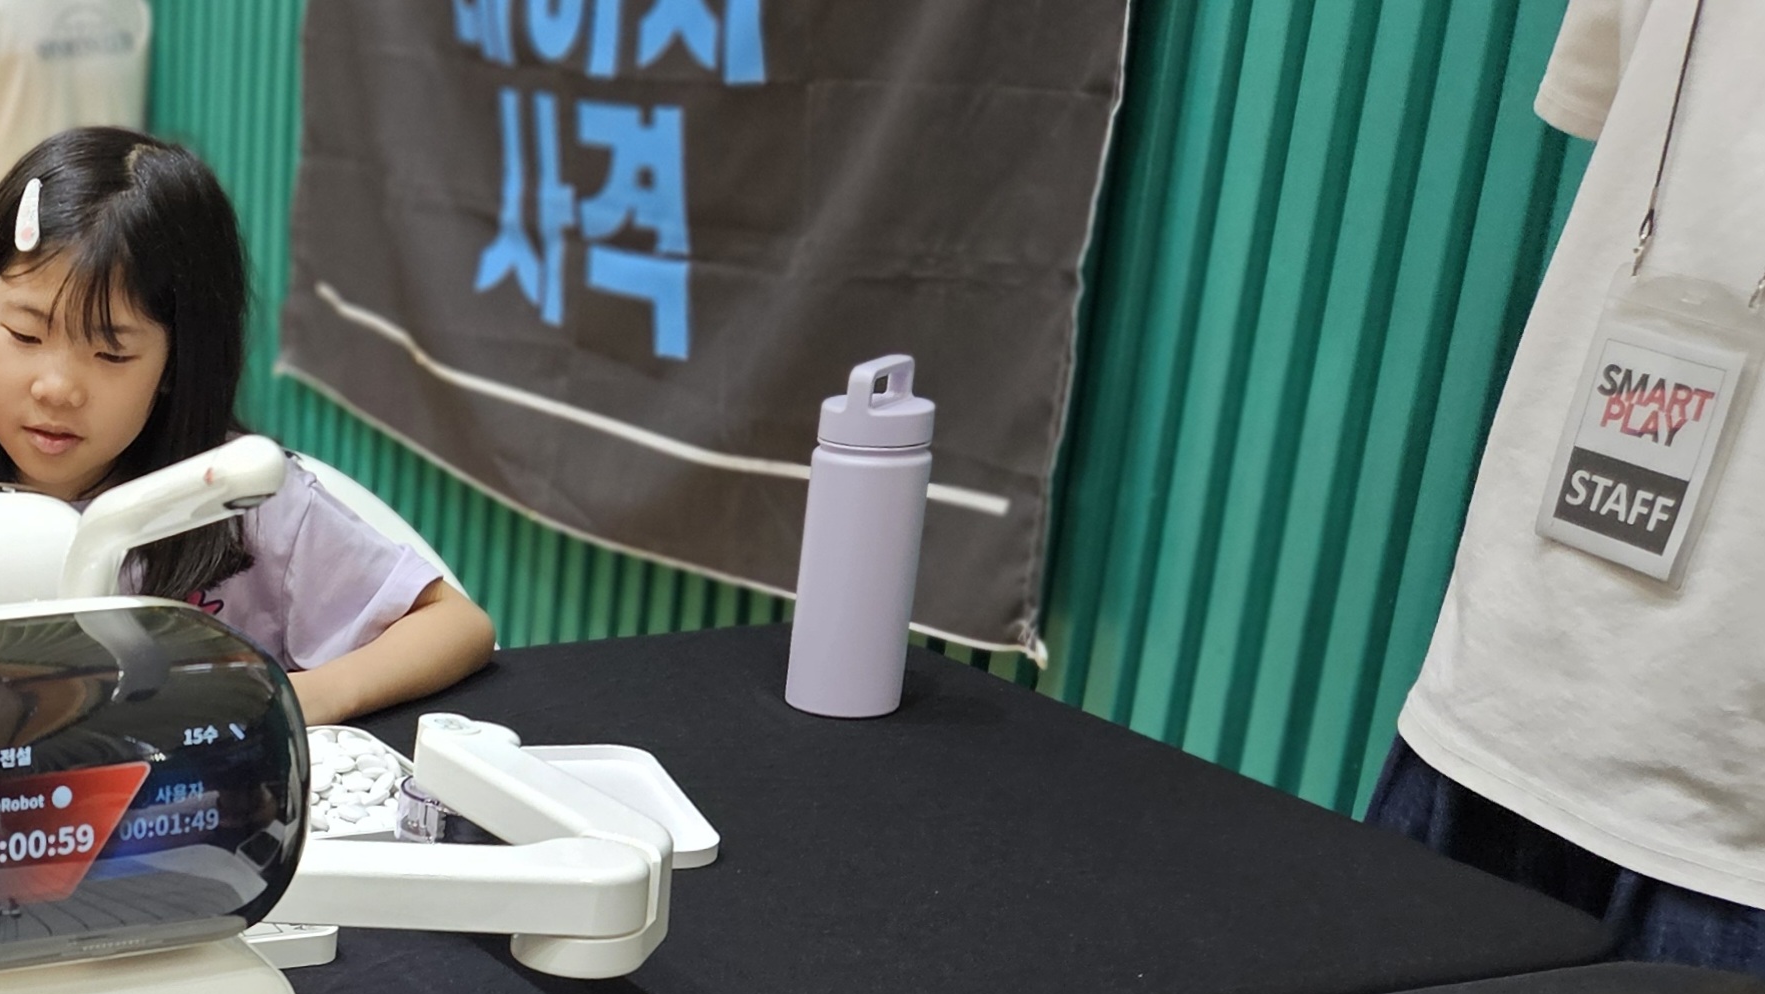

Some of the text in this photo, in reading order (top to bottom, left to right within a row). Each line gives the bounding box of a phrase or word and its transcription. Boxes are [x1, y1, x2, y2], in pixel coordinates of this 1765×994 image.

[475, 88, 690, 361] 사격
[1597, 363, 1715, 422] SMART
[1600, 395, 1688, 447] PLAY
[1565, 470, 1676, 532] STAFF
[183, 725, 218, 747] 15수
[156, 781, 204, 804] 사용자
[119, 808, 220, 842] 00:01:49
